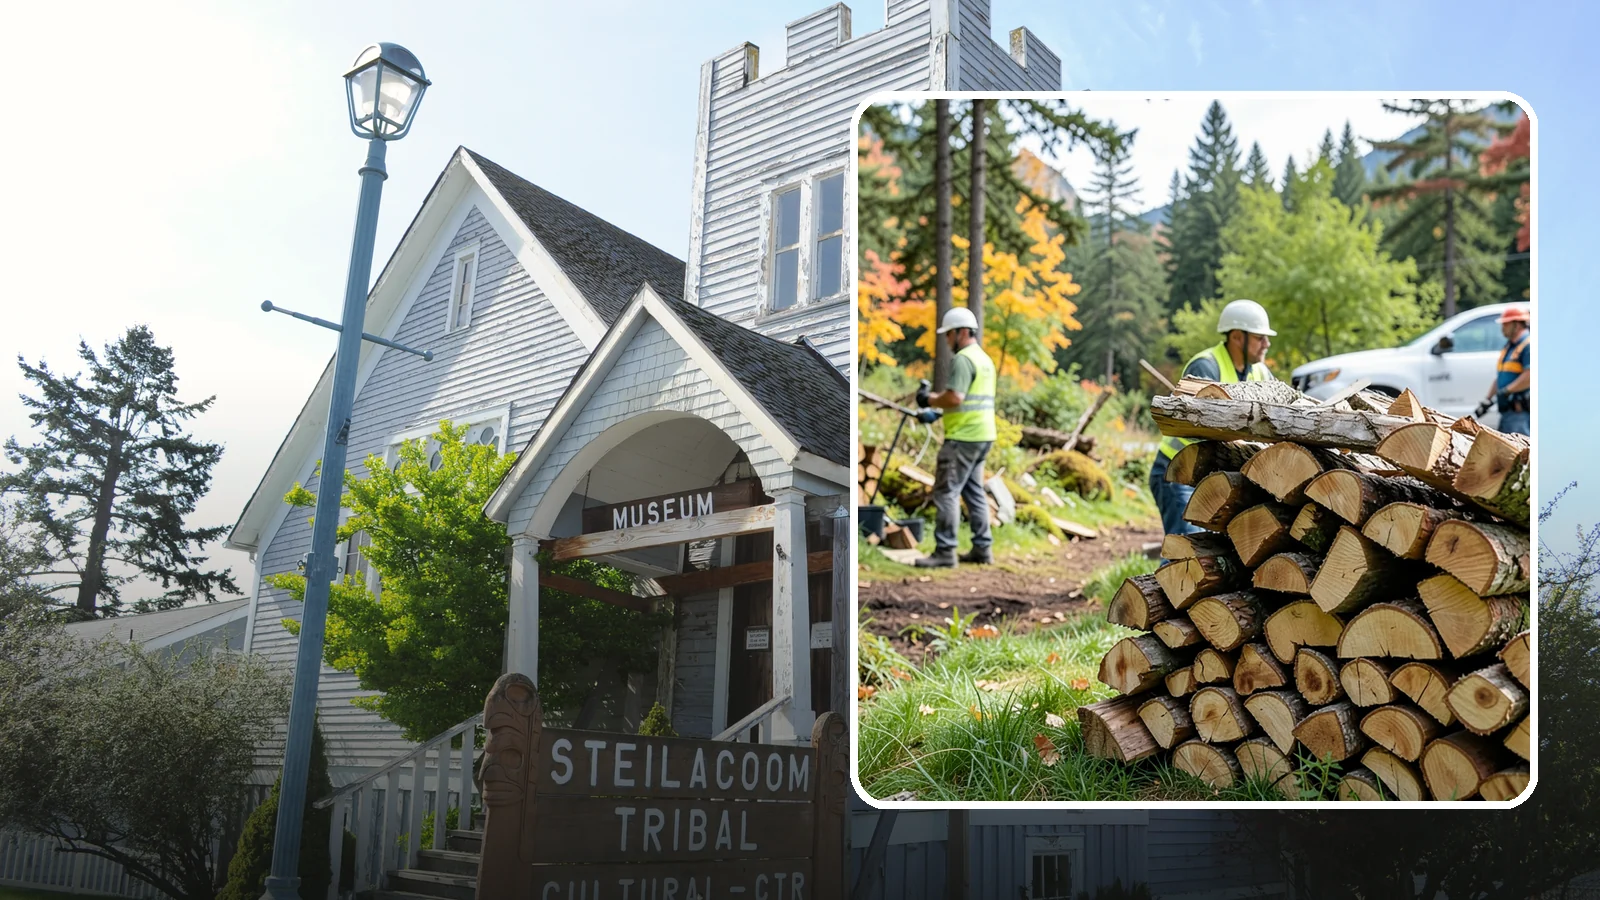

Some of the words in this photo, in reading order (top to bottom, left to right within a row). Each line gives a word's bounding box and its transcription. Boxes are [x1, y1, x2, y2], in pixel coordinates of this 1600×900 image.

[612, 491, 714, 530] MUSEUM
[550, 738, 810, 793] STEILACOOM
[614, 806, 758, 852] TRIBAL
